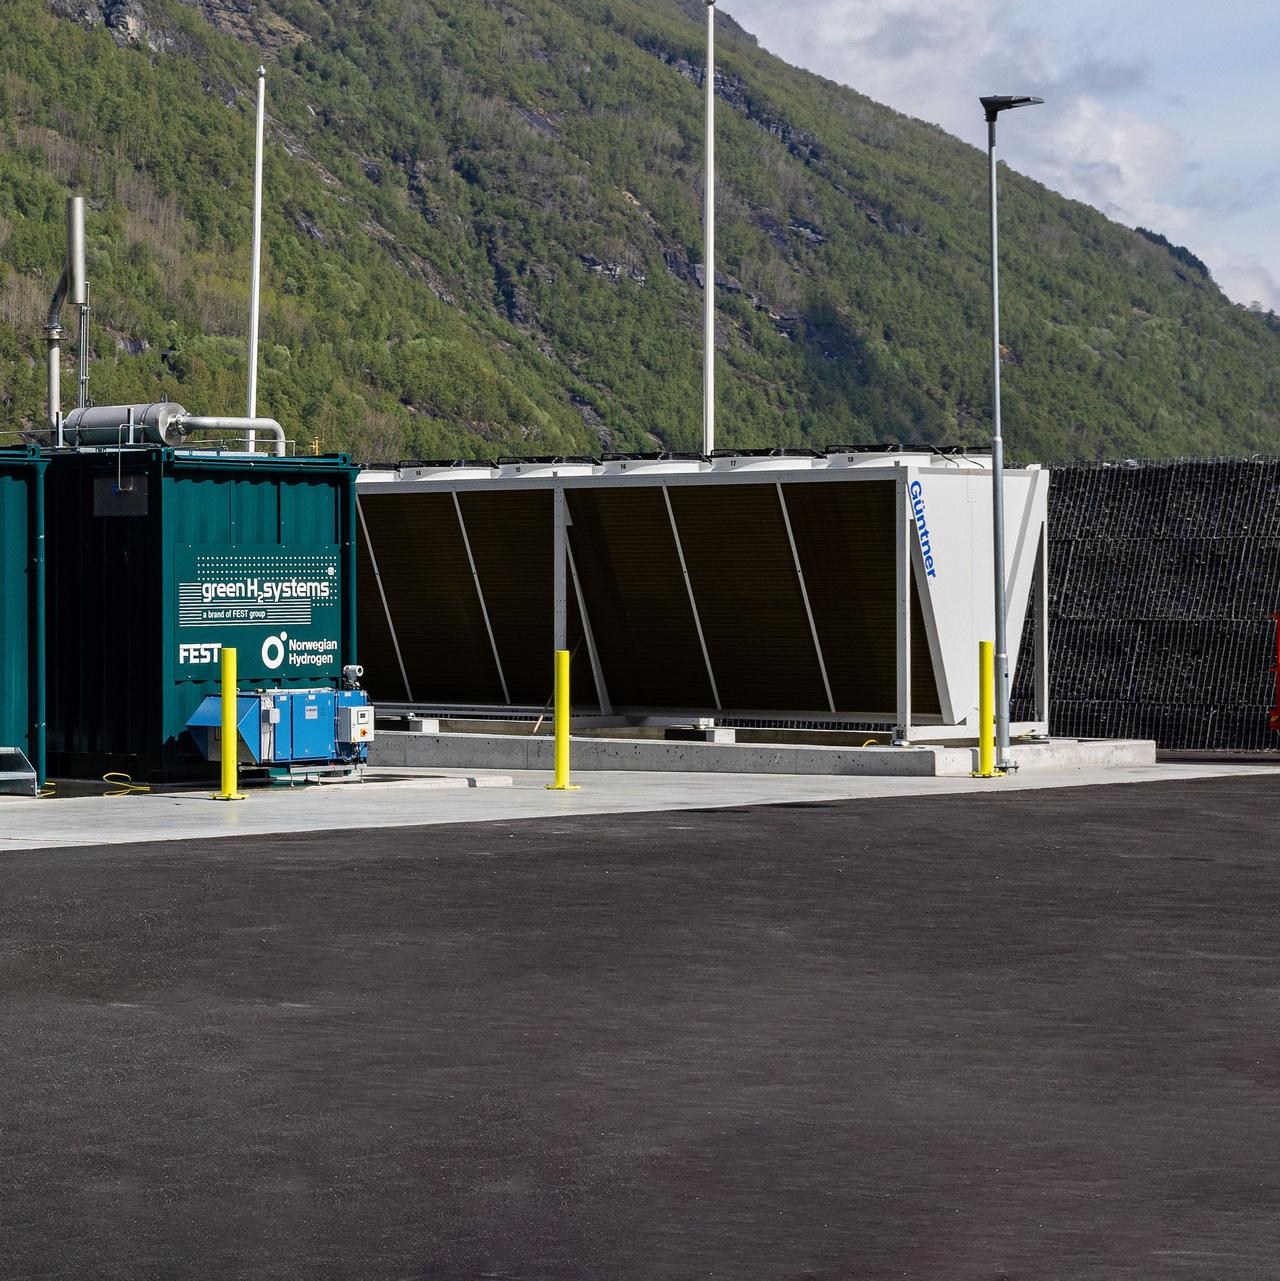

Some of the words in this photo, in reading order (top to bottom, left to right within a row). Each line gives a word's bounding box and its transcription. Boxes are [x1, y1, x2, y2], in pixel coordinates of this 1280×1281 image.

[910, 480, 936, 577] Güntner
[208, 609, 224, 619] brand
[226, 609, 232, 618] of
[233, 609, 248, 618] FEST
[249, 610, 266, 619] group
[289, 639, 338, 652] Norwegian
[179, 643, 222, 664] FEST
[289, 652, 334, 667] Hydrogen
